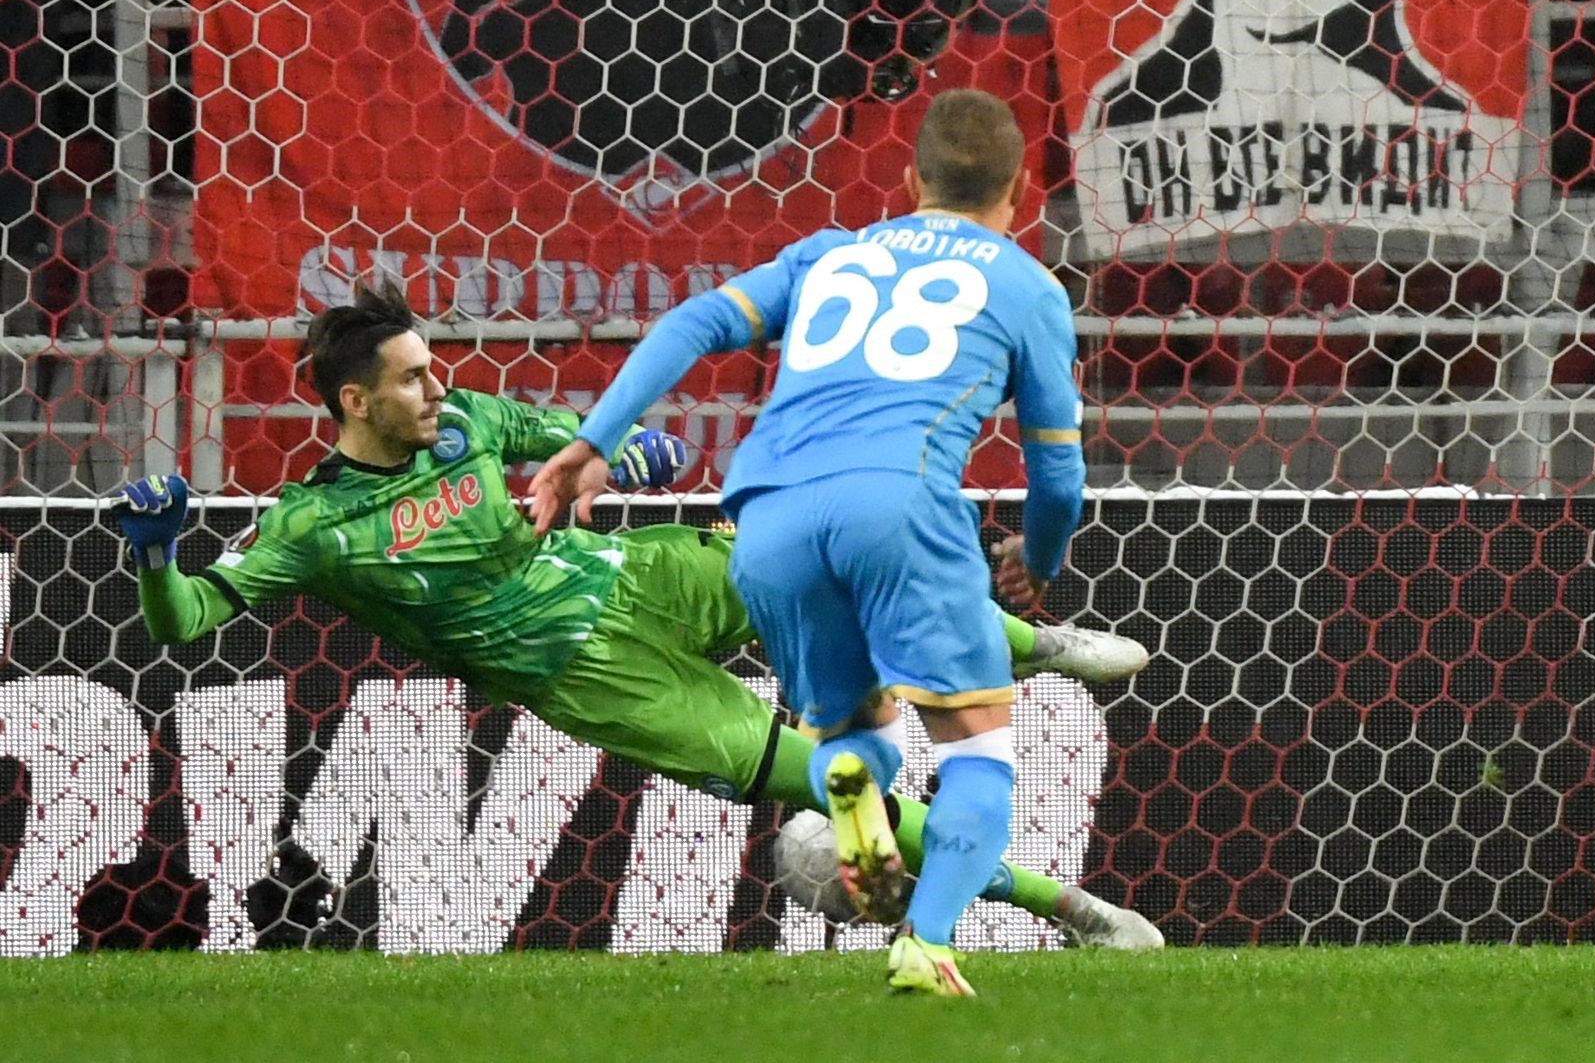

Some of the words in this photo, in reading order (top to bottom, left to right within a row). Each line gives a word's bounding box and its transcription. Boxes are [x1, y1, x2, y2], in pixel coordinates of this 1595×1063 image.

[1120, 129, 1192, 223] ОН
[1302, 122, 1474, 215] ВИДИТ
[786, 241, 990, 382] 68
[384, 473, 481, 559] Lete
